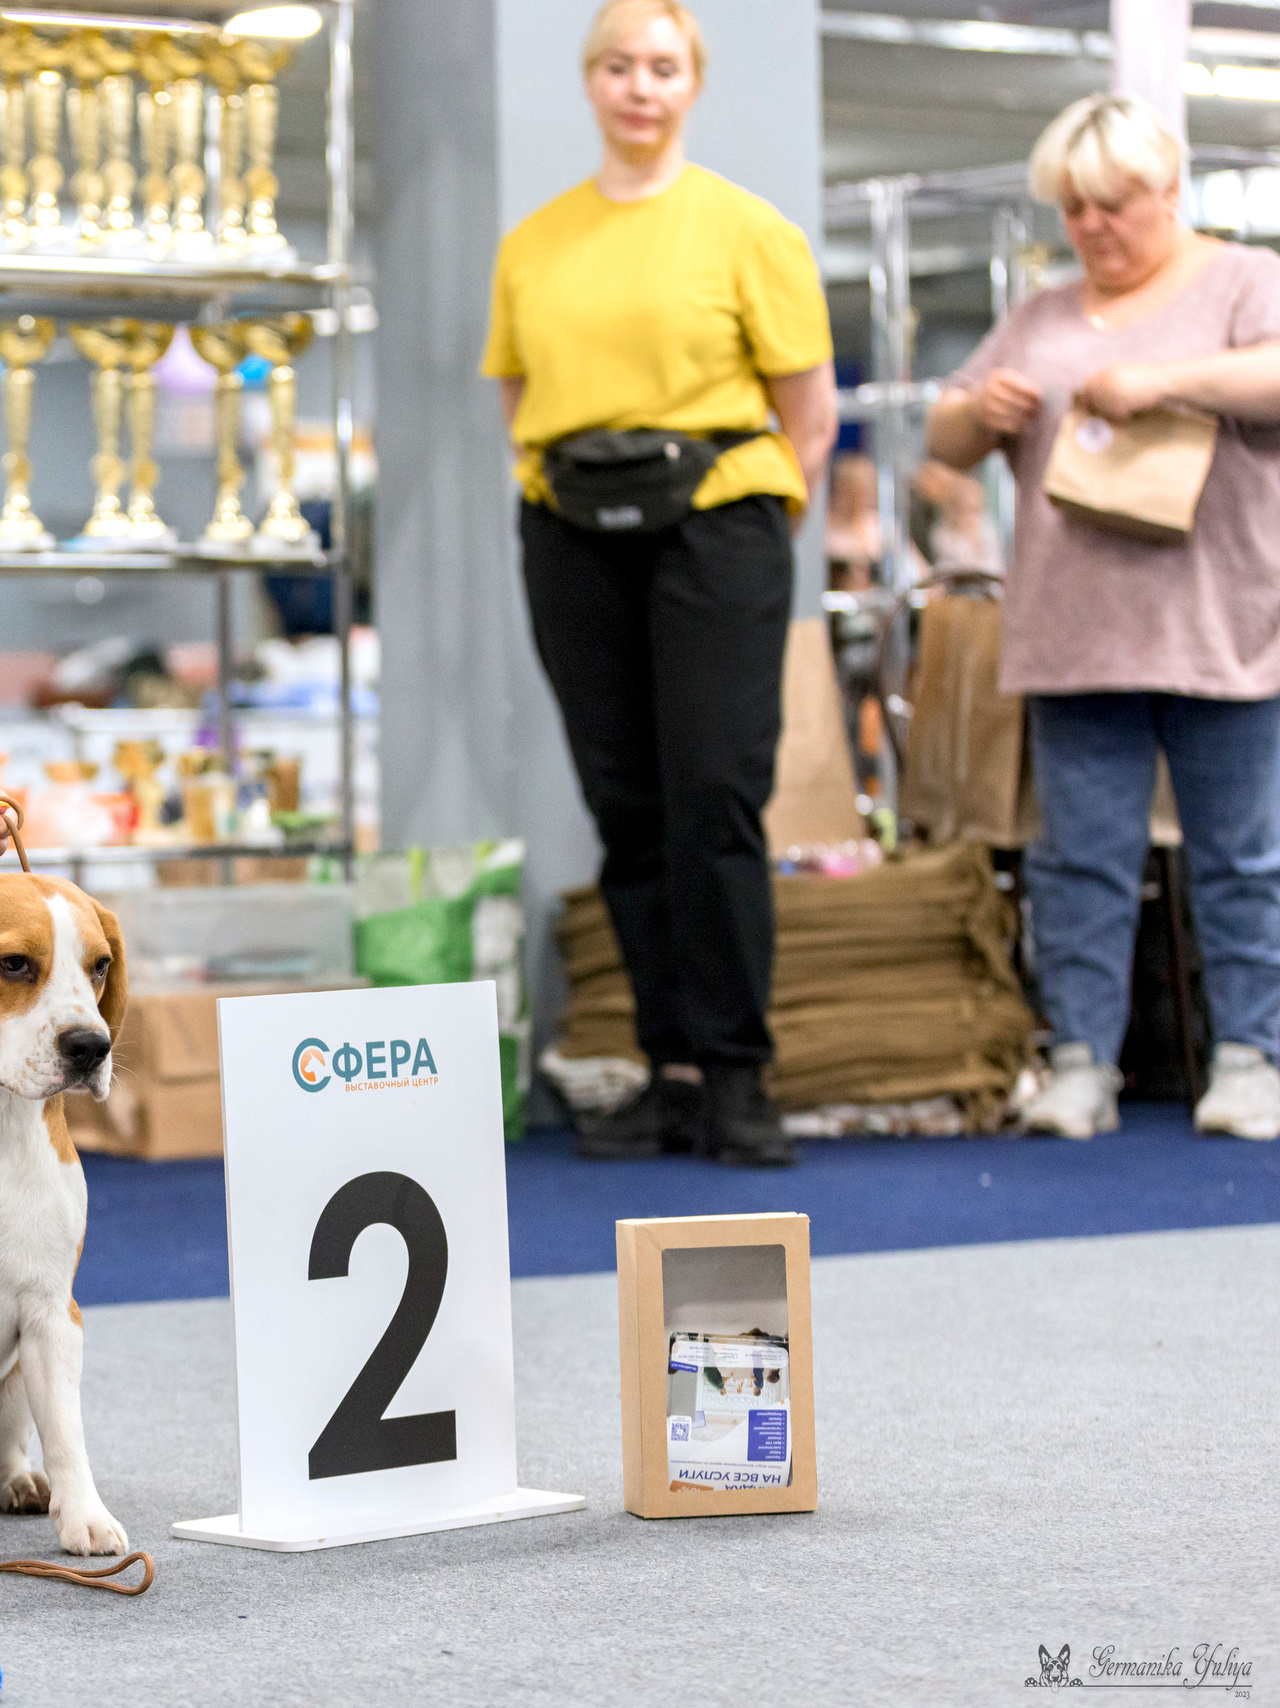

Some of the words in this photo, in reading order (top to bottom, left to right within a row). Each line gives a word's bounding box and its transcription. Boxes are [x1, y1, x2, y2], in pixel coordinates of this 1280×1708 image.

[292, 1037, 438, 1093] СФЕРА
[345, 1077, 410, 1092] ВЫСТАВОЧНЫЙ
[412, 1076, 439, 1088] ЦЕНТР
[308, 1171, 457, 1480] 2
[679, 1469, 730, 1481] УСЛУГИ
[733, 1472, 759, 1483] ВСЕ
[762, 1473, 781, 1484] НА
